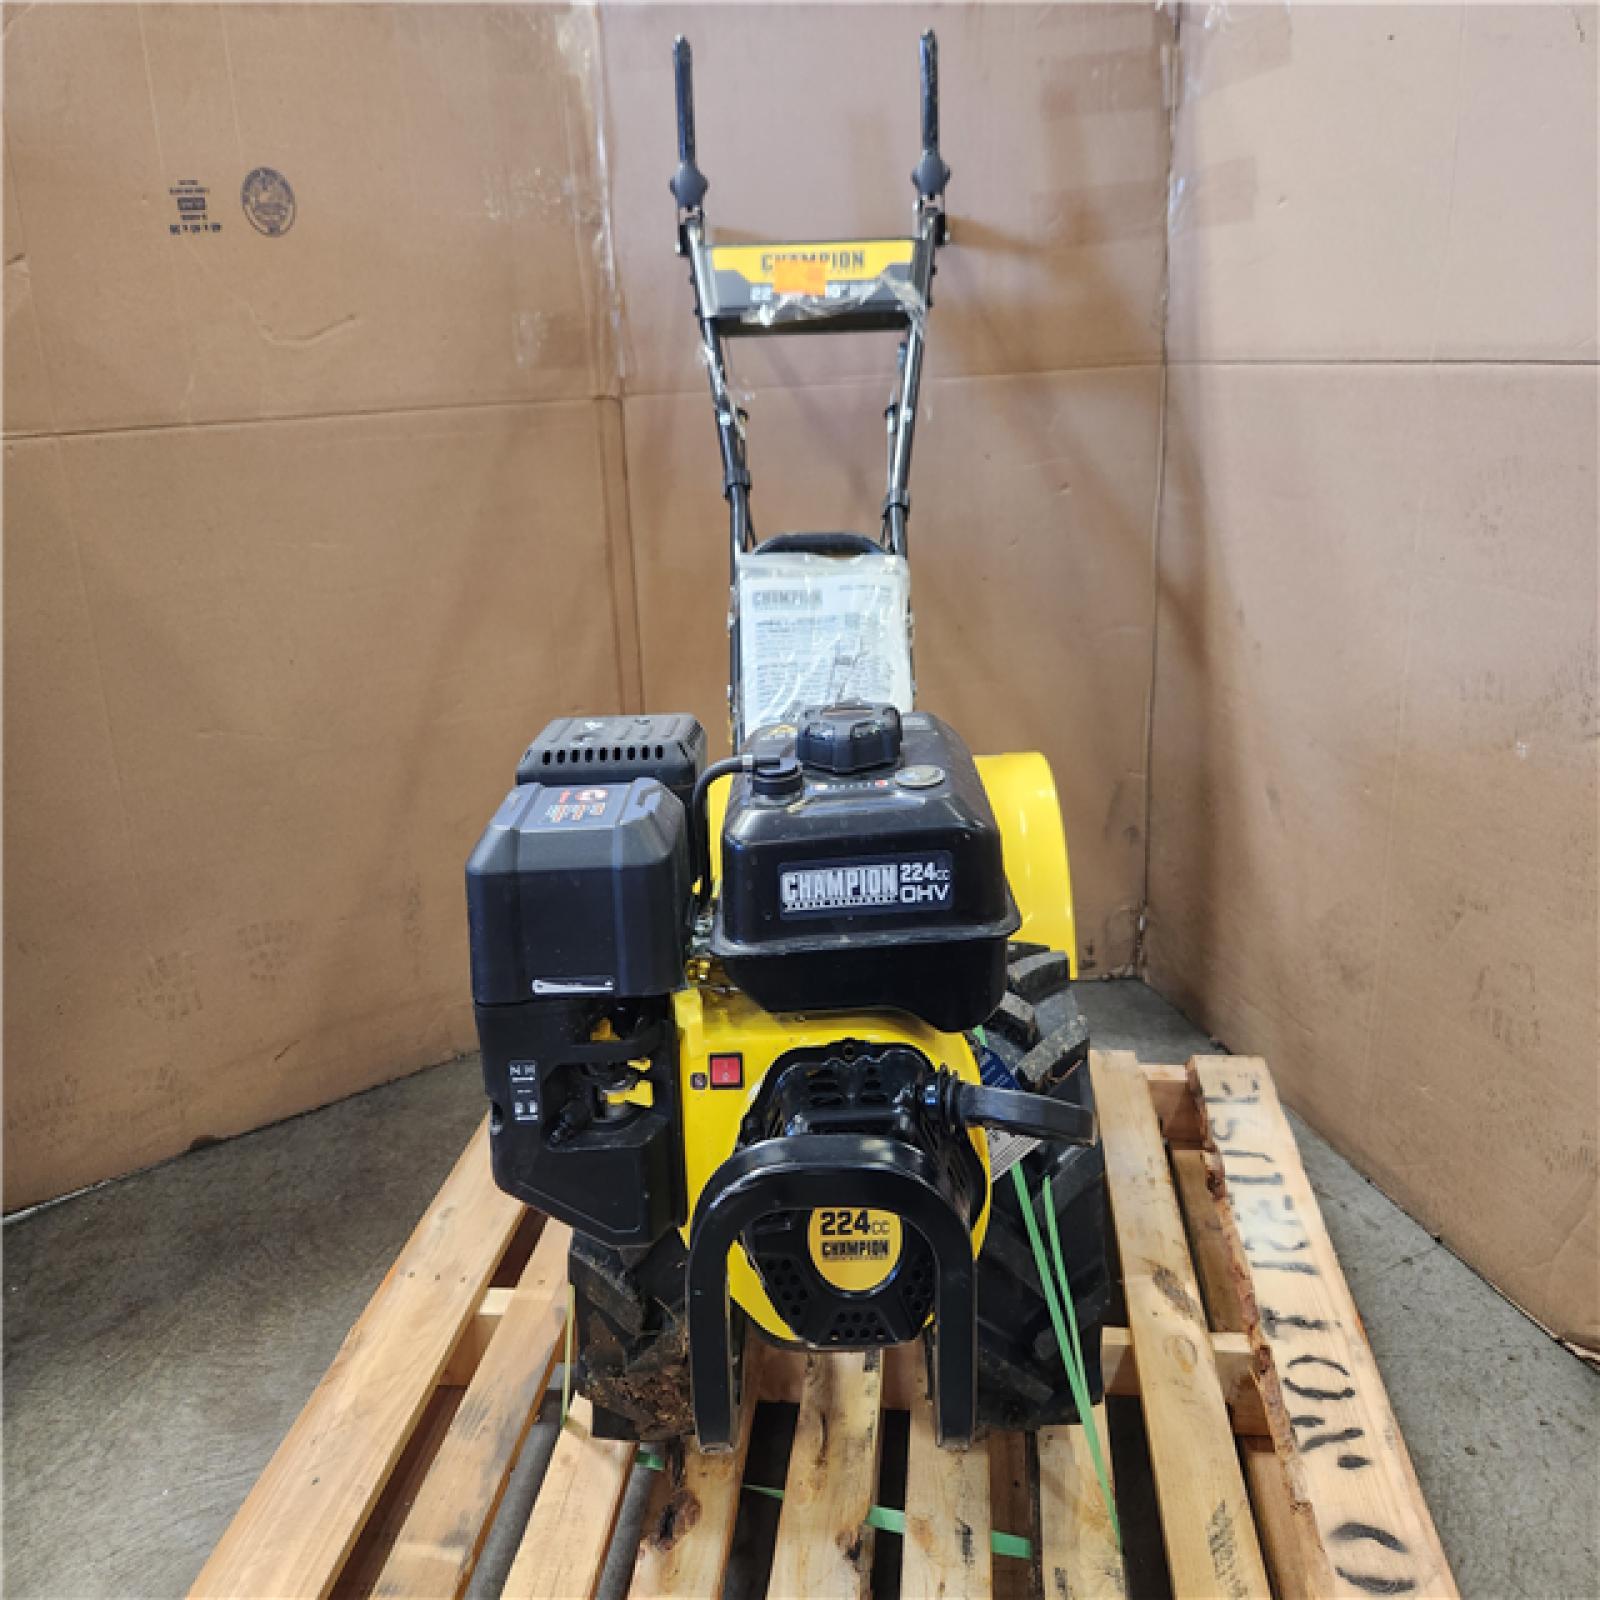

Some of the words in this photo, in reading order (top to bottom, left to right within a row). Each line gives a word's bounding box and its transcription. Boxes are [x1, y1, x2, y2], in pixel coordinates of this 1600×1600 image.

[782, 865, 898, 904] CHAMPION
[901, 884, 950, 903] OHV
[820, 1210, 890, 1235] 224cc
[821, 1240, 889, 1257] CHAMPION
